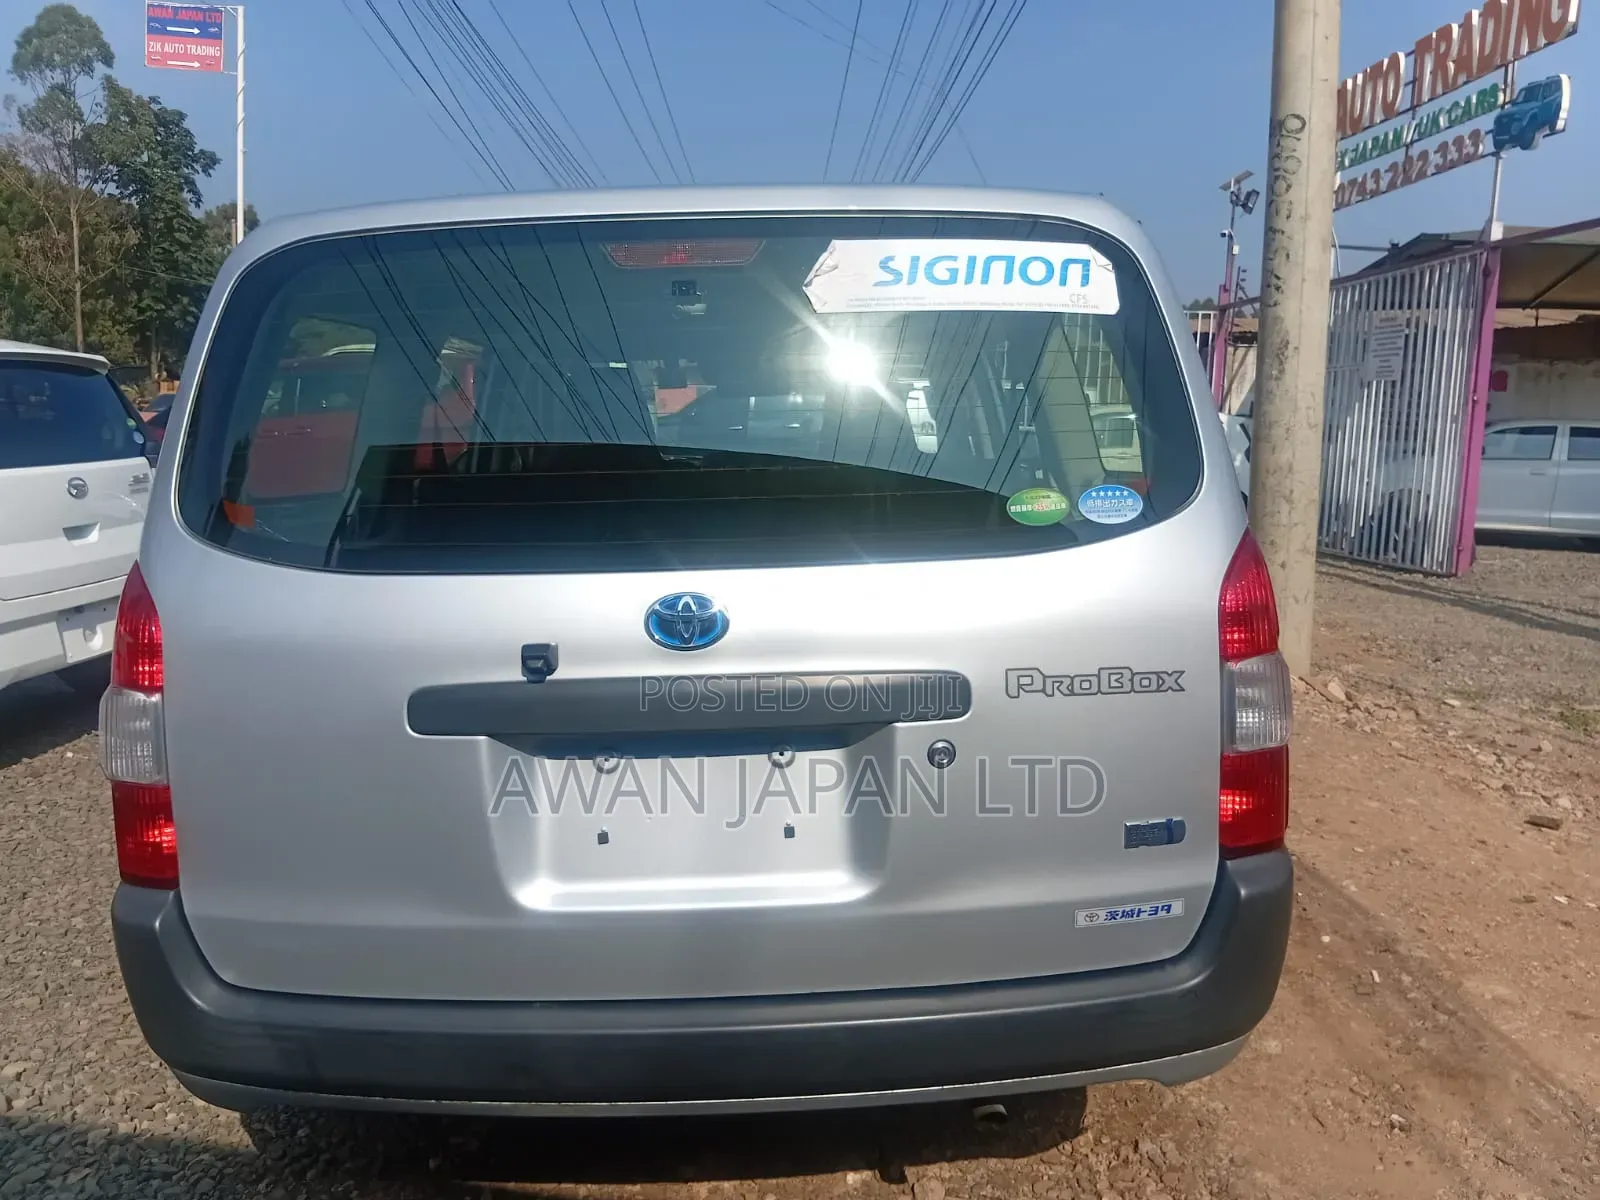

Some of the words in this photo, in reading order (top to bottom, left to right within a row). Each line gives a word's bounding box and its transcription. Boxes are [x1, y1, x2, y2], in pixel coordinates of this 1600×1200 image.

[148, 6, 174, 19] AWAN
[176, 9, 204, 22] JAPAN
[206, 11, 222, 24] LTD
[148, 41, 162, 53] ZIK
[163, 42, 185, 55] AUTO
[187, 44, 221, 57] TRADING
[1337, 51, 1405, 137] AUTO
[1412, 0, 1580, 104] TRADING
[1446, 82, 1503, 126] CARS
[1334, 167, 1382, 208] 0743
[1433, 128, 1485, 173] 333
[1103, 903, 1173, 922] 茨城トヨタ
